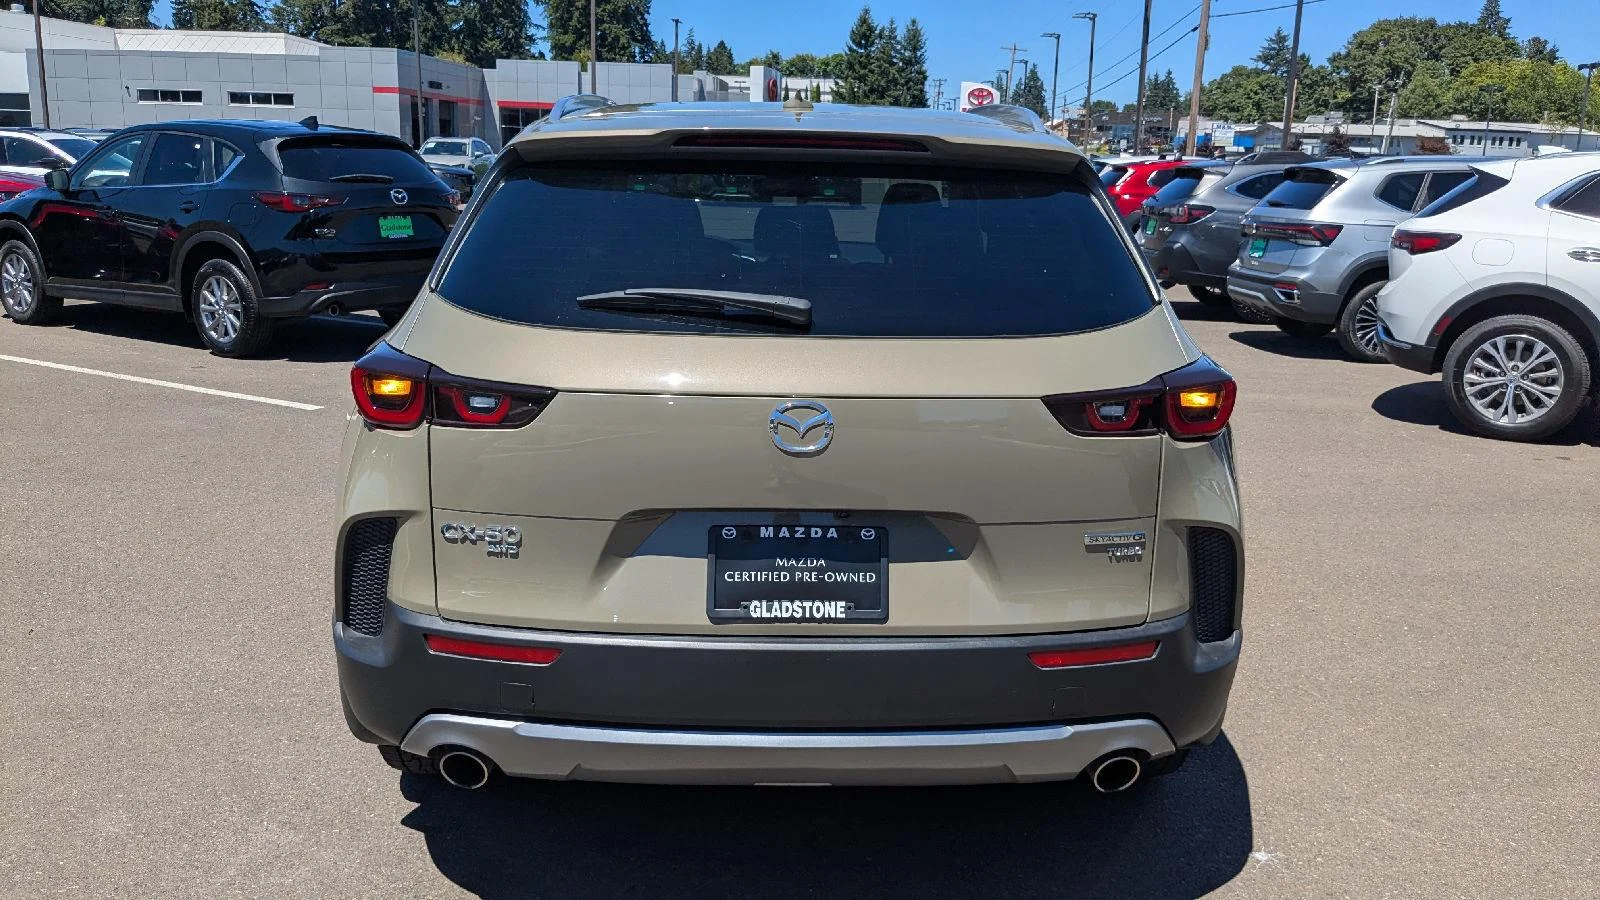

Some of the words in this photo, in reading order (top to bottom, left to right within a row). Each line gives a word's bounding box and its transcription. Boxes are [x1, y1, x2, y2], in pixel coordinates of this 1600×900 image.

[440, 523, 522, 544] CX-50
[760, 526, 838, 538] MAZDA
[1106, 546, 1142, 556] TURBO
[775, 557, 826, 567] MAZDA
[724, 571, 790, 582] CERTIFIED
[795, 571, 876, 583] PRE-OWNED
[749, 600, 846, 619] GLADSTONE
